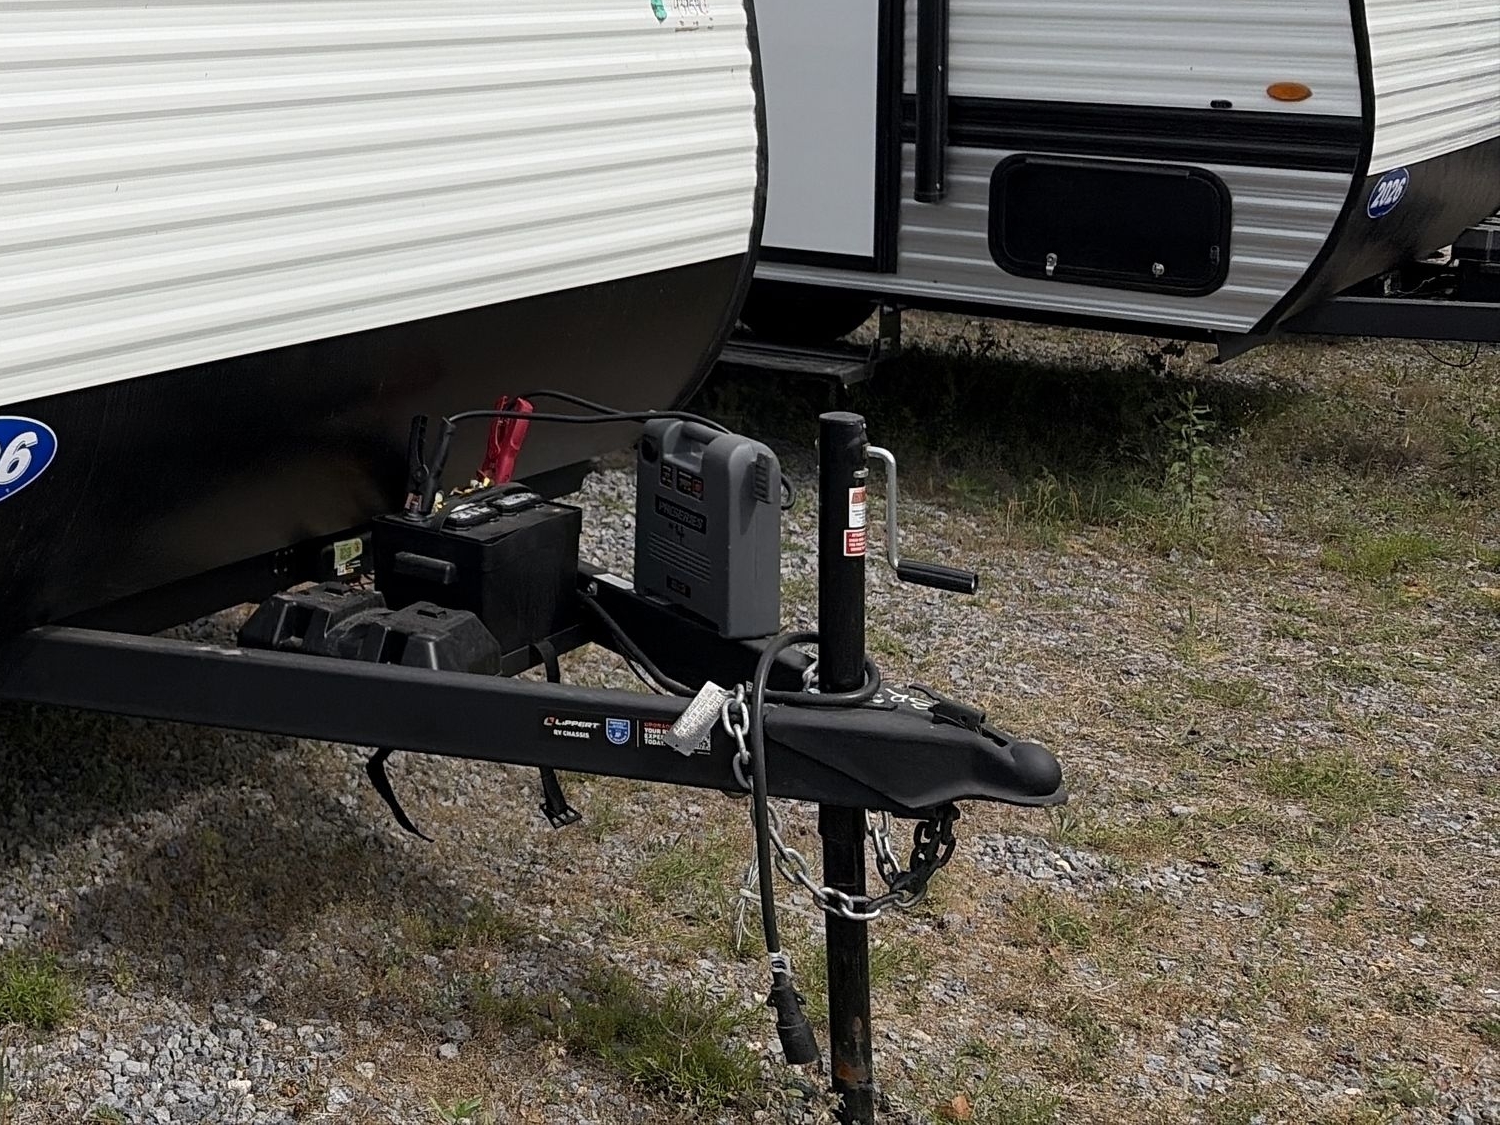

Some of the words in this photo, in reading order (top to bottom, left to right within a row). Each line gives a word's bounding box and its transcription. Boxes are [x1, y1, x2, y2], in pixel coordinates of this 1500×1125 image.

[1369, 176, 1407, 209] 2026
[555, 718, 602, 729] LIPPERT
[562, 730, 590, 739] CHASSIS
